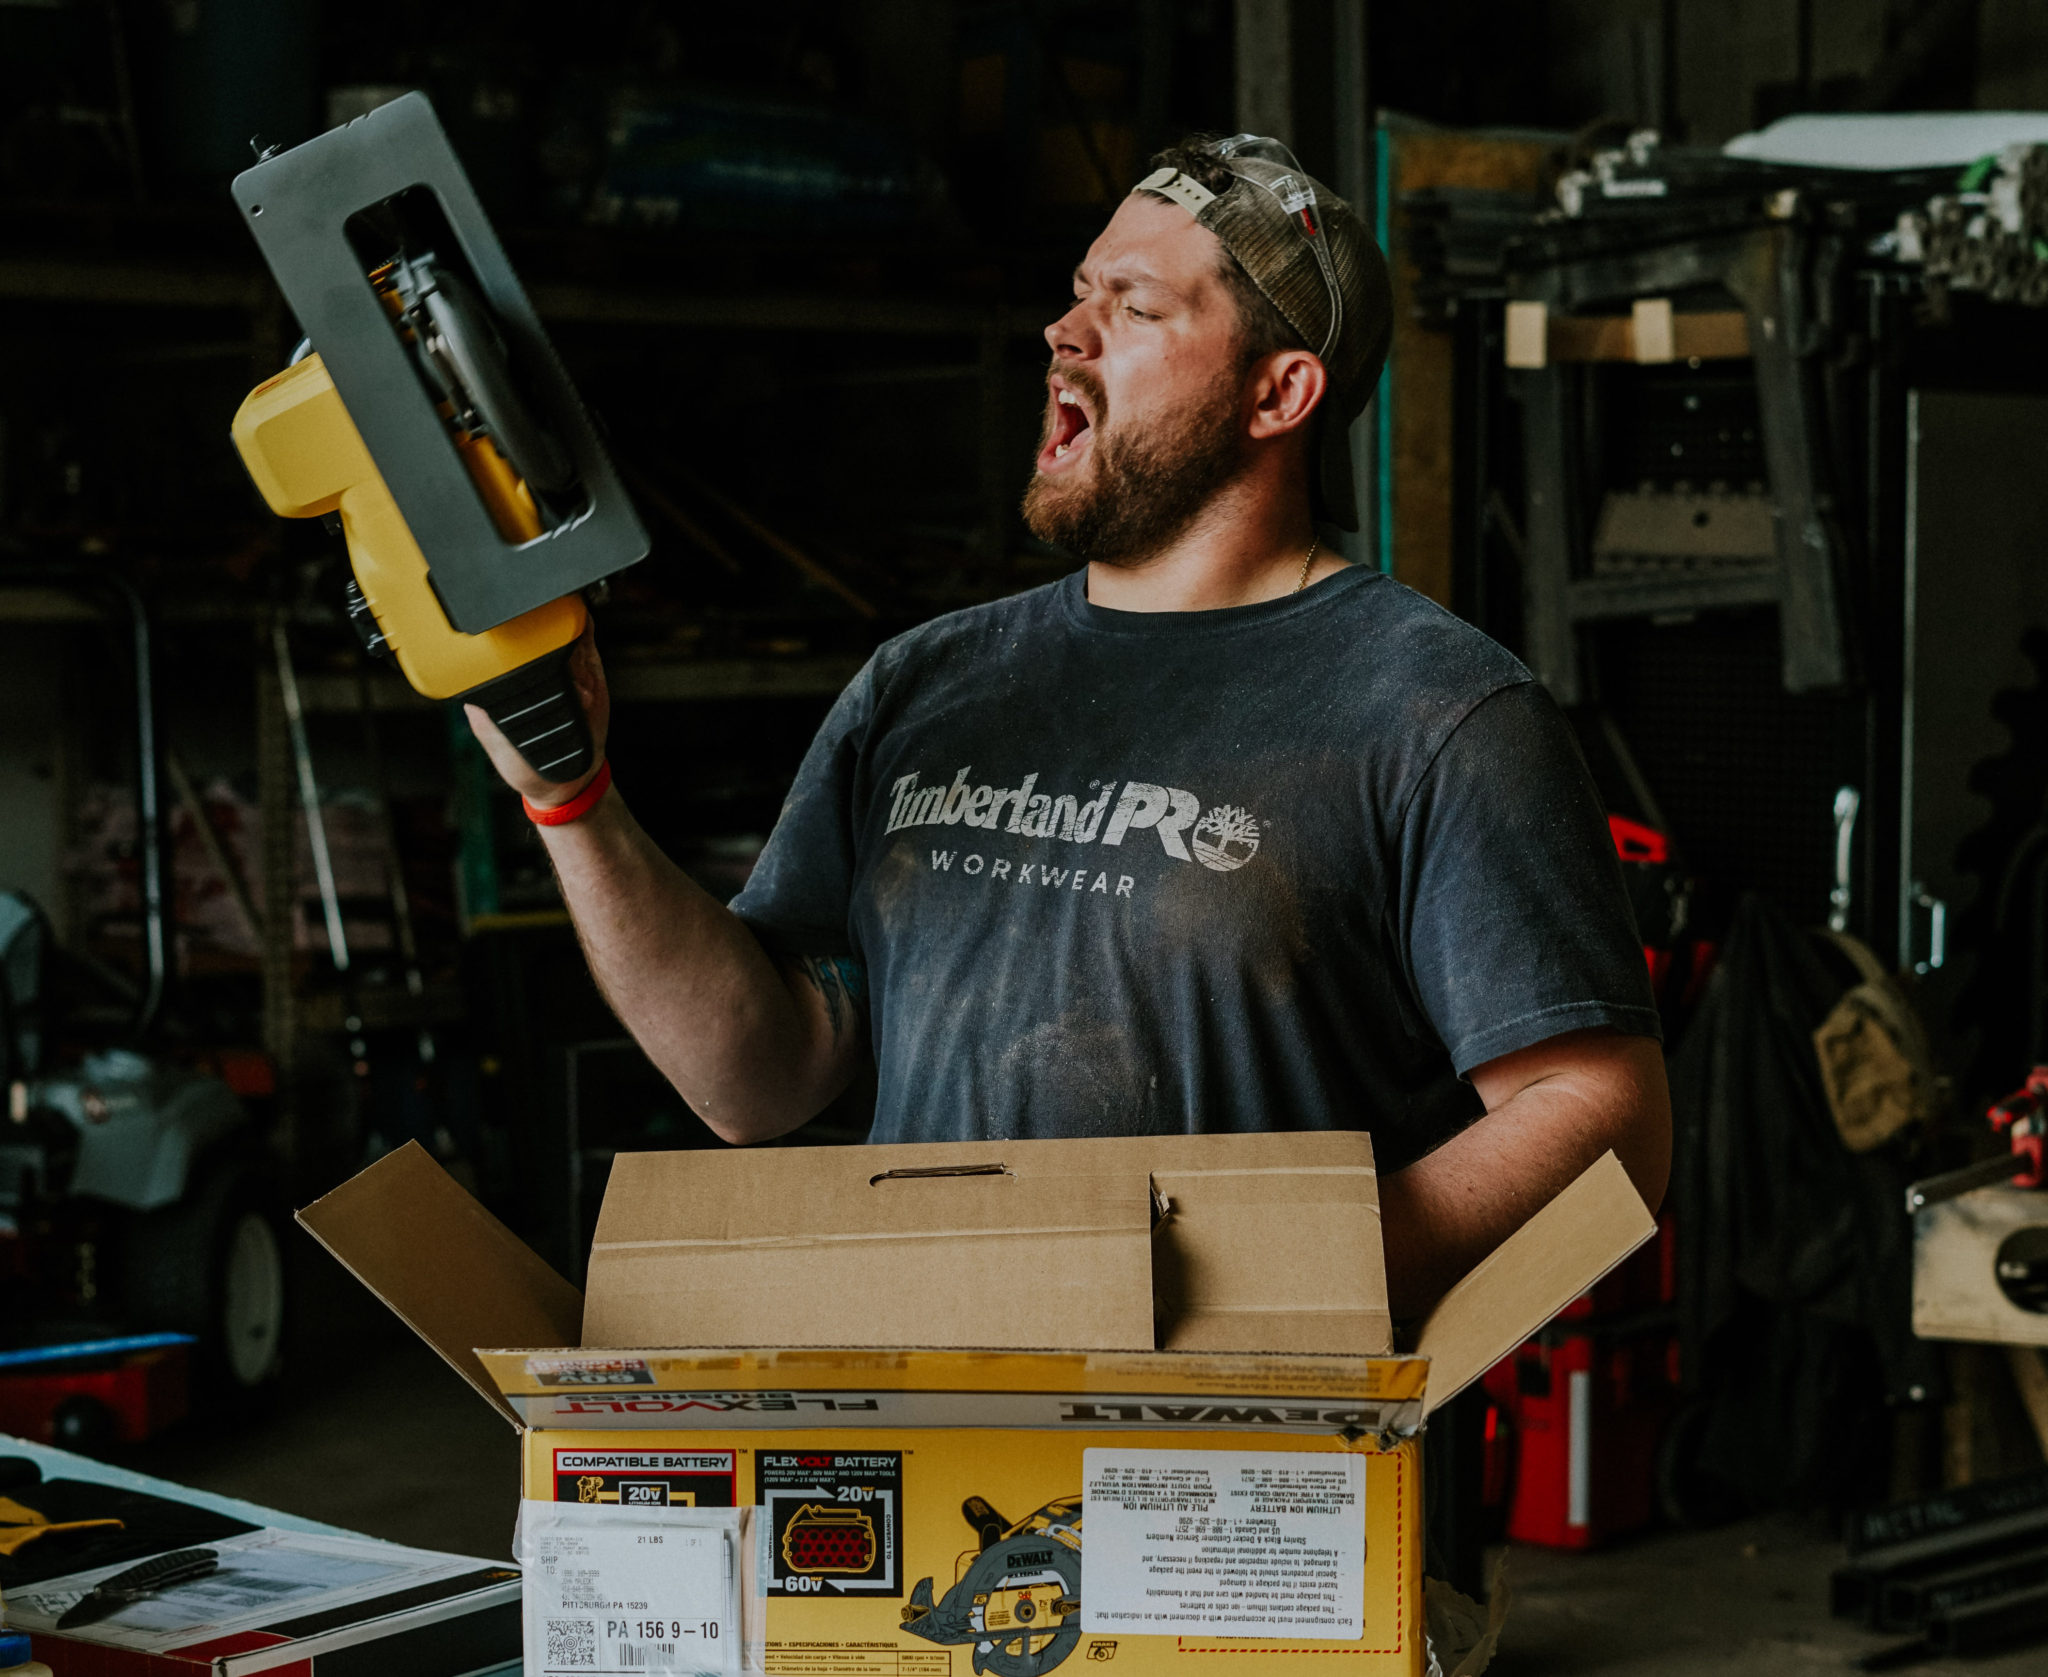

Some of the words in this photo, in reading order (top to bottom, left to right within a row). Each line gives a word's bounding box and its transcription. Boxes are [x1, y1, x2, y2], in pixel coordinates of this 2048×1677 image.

[884, 766, 1116, 843] Timberland
[931, 850, 1135, 898] WORKWEAR
[555, 1398, 879, 1414] FLEXVOLT
[562, 1456, 659, 1467] COMPATIBLE
[664, 1457, 728, 1467] BATTERY
[763, 1456, 832, 1467] FLEXVOLT
[834, 1457, 896, 1467] BATTERY
[1122, 1502, 1137, 1510] ION
[1139, 1502, 1174, 1511] LITHIUM
[1177, 1503, 1188, 1511] AU
[1192, 1504, 1208, 1512] PILE
[1250, 1504, 1287, 1513] BATTERY
[1289, 1505, 1304, 1514] ION
[1306, 1506, 1341, 1515] LITHIUM
[1245, 1518, 1277, 1527] Elsewhere
[1235, 1526, 1256, 1534] Canada
[1272, 1527, 1280, 1535] US
[637, 1536, 646, 1544] 21
[649, 1536, 663, 1544] LBS
[1146, 1533, 1174, 1542] Numbers
[1176, 1534, 1199, 1543] Service
[1201, 1535, 1231, 1543] Customer
[1264, 1536, 1282, 1544] Black
[1283, 1536, 1307, 1546] Stanley
[886, 1550, 891, 1560] TO
[1237, 1547, 1266, 1555] additional
[1268, 1548, 1277, 1556] for
[1279, 1548, 1301, 1556] number
[1303, 1548, 1332, 1557] telephone
[1334, 1550, 1338, 1558] A
[541, 1556, 558, 1564] SHIP
[1142, 1555, 1153, 1563] and
[1194, 1556, 1223, 1564] repacking
[1238, 1557, 1268, 1565] inspection
[1149, 1566, 1174, 1575] package
[1186, 1567, 1202, 1575] event
[1204, 1568, 1214, 1576] the
[1223, 1568, 1248, 1576] followed
[1281, 1569, 1314, 1578] procedures
[1316, 1570, 1337, 1579] Special
[1256, 1580, 1280, 1588] package
[1318, 1582, 1338, 1590] hazard
[1146, 1588, 1183, 1598] flammability
[1190, 1590, 1202, 1598] that
[1203, 1590, 1214, 1598] and
[1271, 1592, 1278, 1600] be
[1280, 1592, 1295, 1600] must
[1296, 1592, 1321, 1600] package
[1323, 1594, 1336, 1602] This
[627, 1602, 648, 1610] 15239
[1180, 1602, 1206, 1610] batteries
[1215, 1603, 1229, 1611] cells
[1296, 1605, 1320, 1613] package
[1322, 1606, 1335, 1614] This
[1111, 1612, 1142, 1620] indication
[1154, 1613, 1168, 1621] with
[1169, 1614, 1200, 1622] document
[1224, 1614, 1266, 1623] accompanied
[1268, 1616, 1276, 1624] be
[1277, 1616, 1293, 1624] must
[1295, 1616, 1336, 1625] consignment
[1337, 1618, 1353, 1626] Each
[608, 1621, 628, 1638] PA
[636, 1621, 664, 1638] 156
